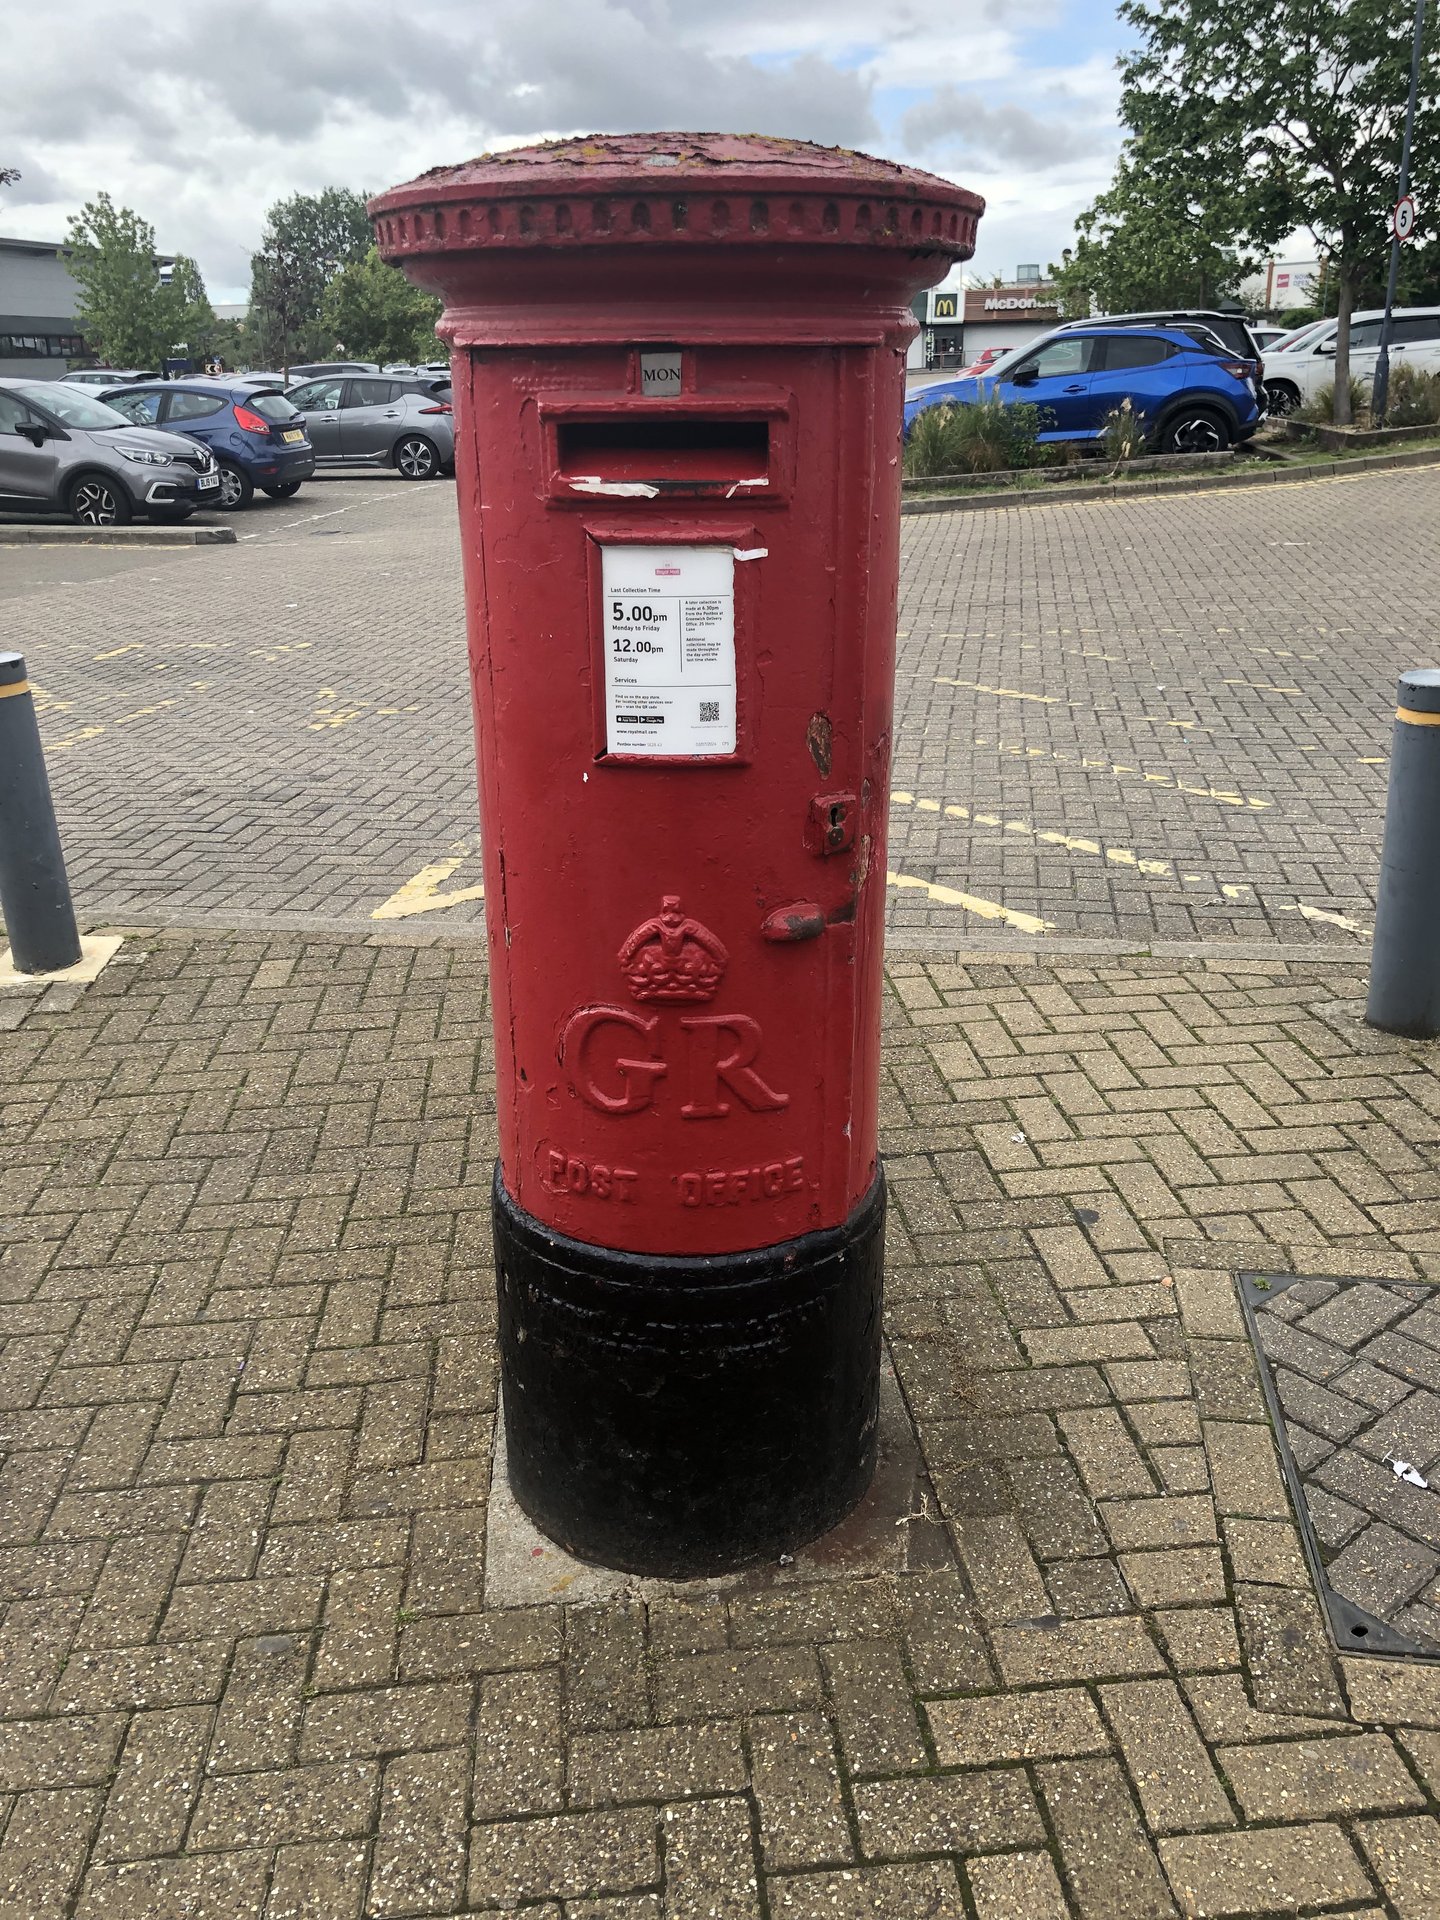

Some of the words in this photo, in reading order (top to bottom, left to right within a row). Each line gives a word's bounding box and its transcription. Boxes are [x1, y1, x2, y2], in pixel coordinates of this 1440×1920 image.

[1400, 210, 1407, 227] 5
[643, 368, 681, 382] MON
[613, 602, 667, 623] 5.00pm
[613, 638, 664, 654] 12.00pm
[562, 1005, 790, 1119] GR
[548, 1149, 638, 1203] POST
[678, 1156, 804, 1208] OFFICE
